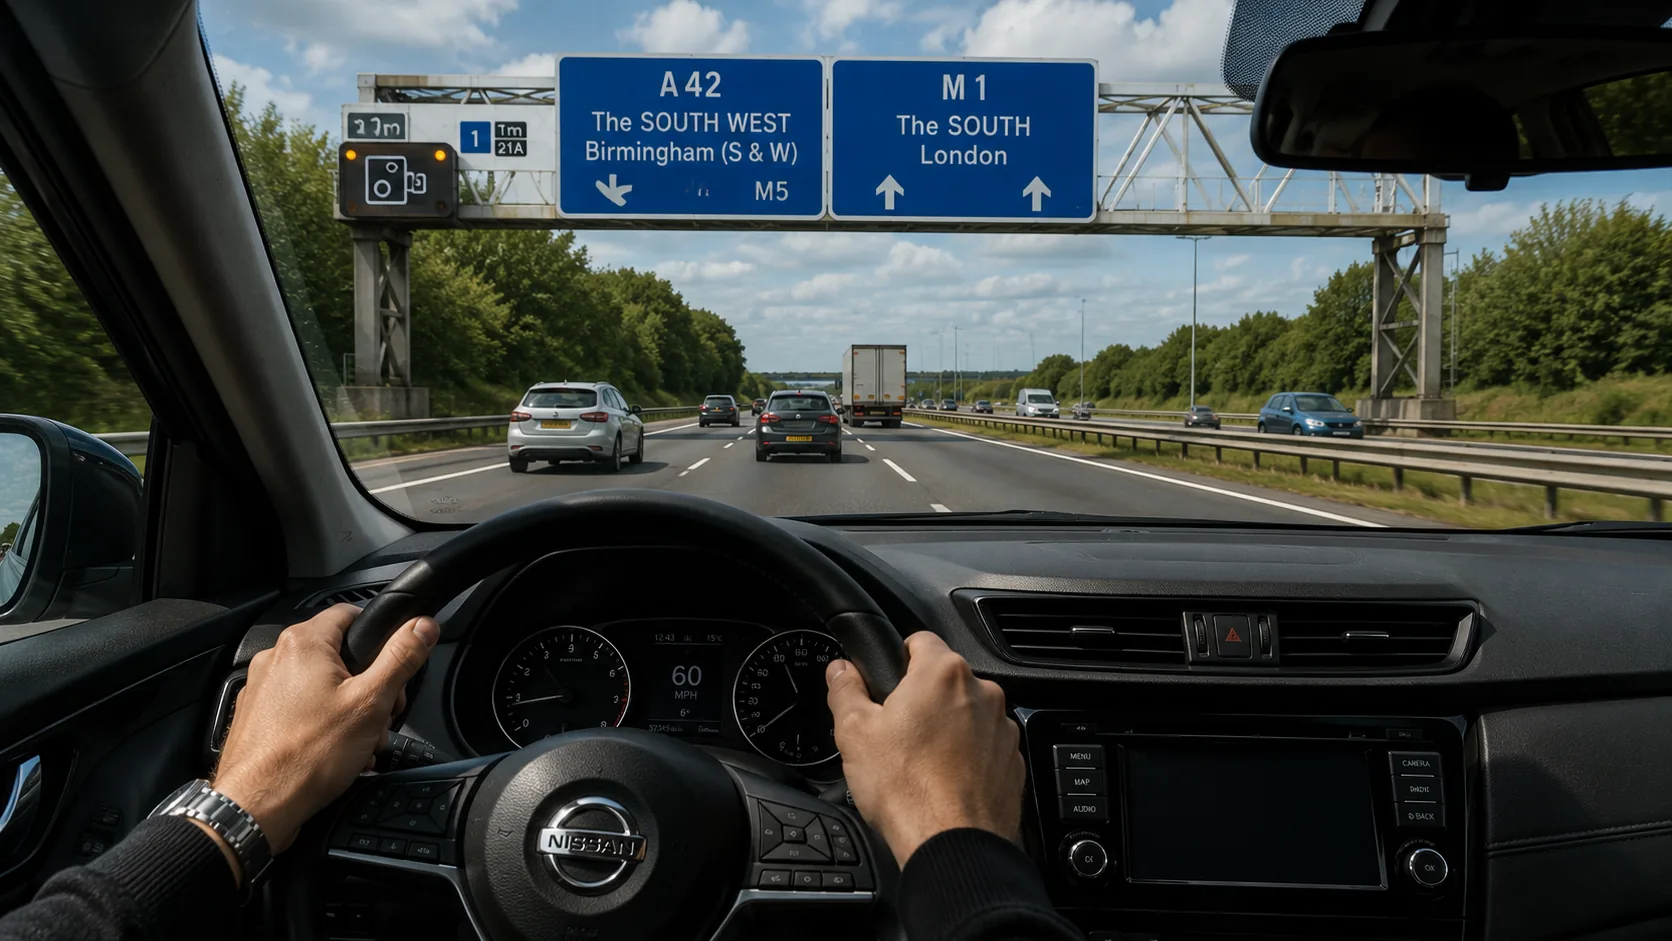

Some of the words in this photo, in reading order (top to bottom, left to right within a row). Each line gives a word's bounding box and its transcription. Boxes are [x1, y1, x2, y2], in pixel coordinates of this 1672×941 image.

[684, 70, 722, 98] 42
[591, 111, 633, 132] The
[640, 111, 719, 133] SOUTH
[727, 112, 792, 134] WEST
[896, 114, 939, 136] The
[948, 115, 1031, 137] SOUTH
[470, 129, 479, 148] 1
[497, 141, 525, 155] 21A
[585, 140, 715, 167] Birmingham
[721, 141, 743, 166] (S
[748, 142, 764, 163] &
[770, 142, 798, 166] W)
[920, 144, 1008, 166] London
[755, 180, 790, 202] M5
[671, 665, 703, 687] 60
[674, 690, 698, 700] MPH
[1069, 752, 1092, 761] MENU
[1073, 778, 1091, 786] MAP
[1072, 805, 1097, 813] AUDIO
[1415, 812, 1436, 821] BACK
[547, 834, 636, 857] NISSAN
